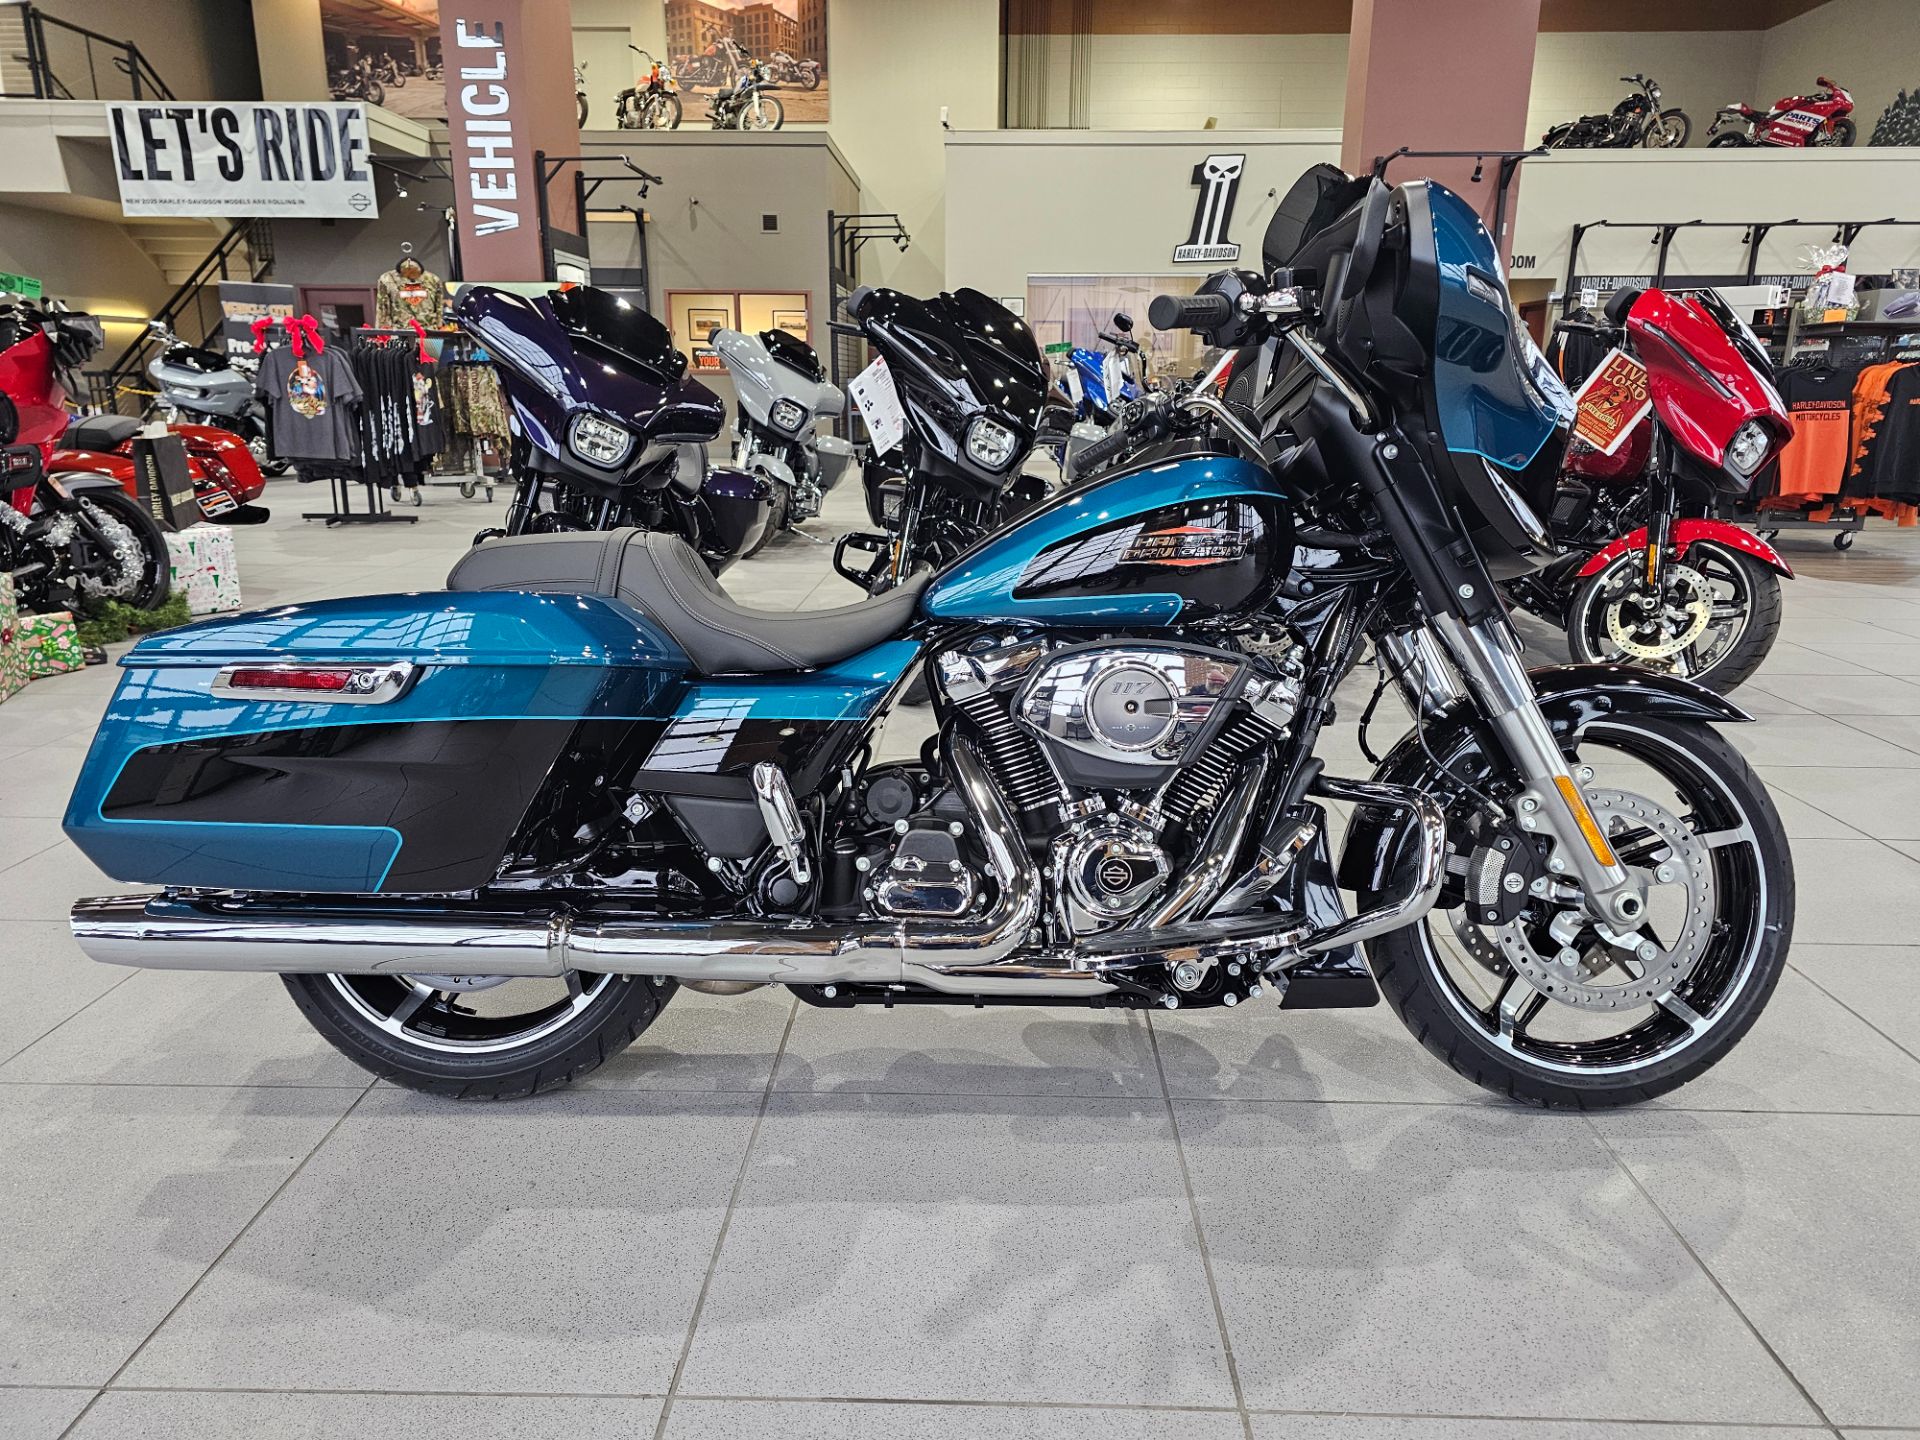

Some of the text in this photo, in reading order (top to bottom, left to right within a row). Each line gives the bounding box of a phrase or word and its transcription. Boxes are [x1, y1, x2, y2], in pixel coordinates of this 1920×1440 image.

[1785, 112, 1821, 125] PARTS
[456, 18, 520, 237] VEHICLE
[111, 107, 369, 182] LET'S RIDE
[1177, 247, 1237, 259] HARLEY-DAVIDSON
[1580, 277, 1652, 290] HARLEY-DAVIDSON
[1760, 277, 1815, 289] HARLEY-DAVI
[699, 356, 721, 367] YOUR
[1611, 356, 1648, 387] LIVE
[1792, 400, 1846, 410] HARLEY-DAVIDSON
[1586, 403, 1599, 415] LIVE
[1598, 412, 1614, 425] LOUD
[1795, 412, 1841, 421] MOTORCYCLES
[145, 454, 165, 519] HARLEY DAVIDSON
[1112, 681, 1155, 695] 117
